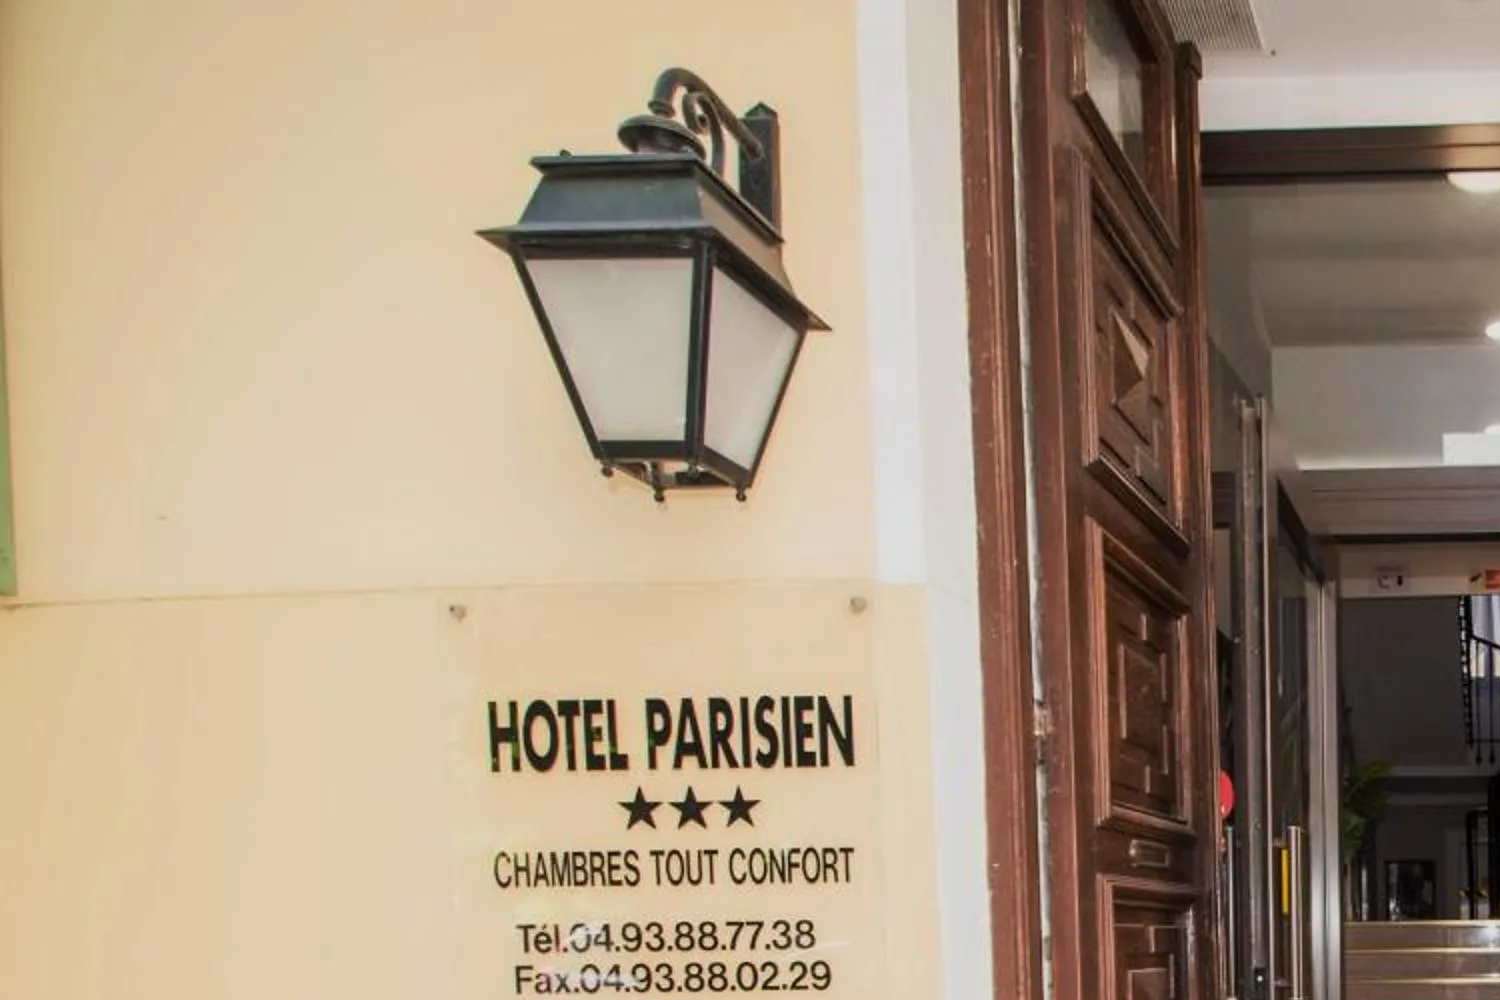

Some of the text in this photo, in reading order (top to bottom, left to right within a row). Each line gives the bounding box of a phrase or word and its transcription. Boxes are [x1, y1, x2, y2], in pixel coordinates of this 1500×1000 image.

[487, 695, 856, 773] HOTEL PARISIEN
[493, 846, 855, 888] CHAMBRES TOUT CONFORT
[516, 920, 816, 953] Tél.04.93.88.77.38
[514, 961, 832, 995] Fax.04.93.88.02.29
